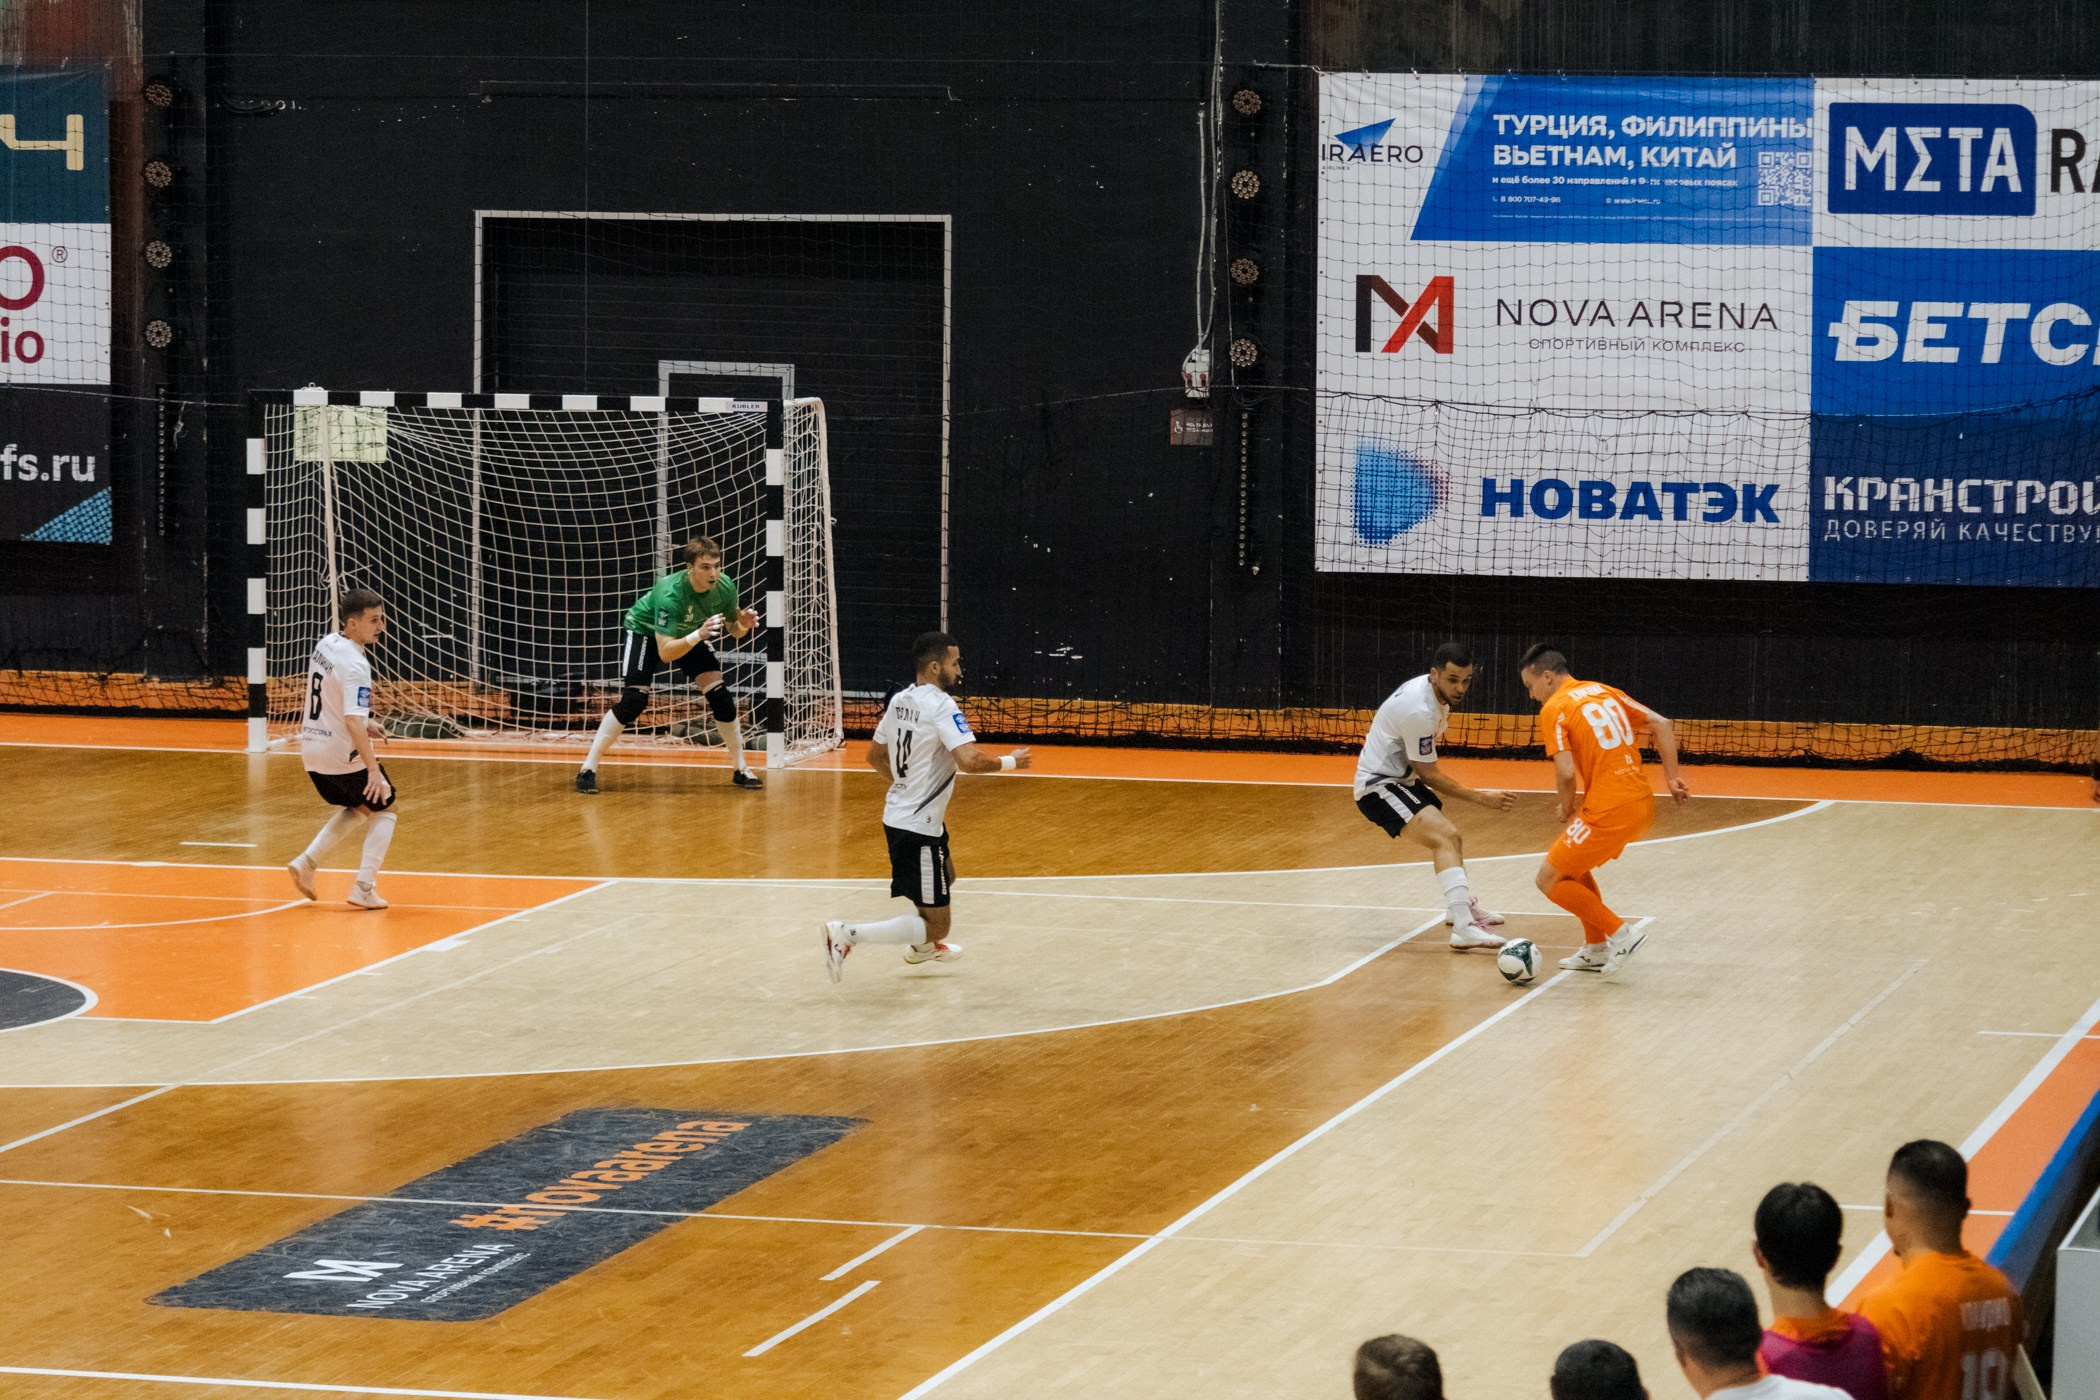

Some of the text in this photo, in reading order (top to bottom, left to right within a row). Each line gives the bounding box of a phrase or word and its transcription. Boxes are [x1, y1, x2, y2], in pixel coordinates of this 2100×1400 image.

[1492, 114, 1813, 140] ТУРЦИЯ, ФИЛИППИНЫ
[1321, 143, 1424, 163] IRAERO
[1493, 141, 1737, 171] ВЬЕТНАМ, КИТАЙ
[1500, 175, 1520, 185] ещё
[1522, 176, 1550, 184] более
[1552, 176, 1565, 185] 30
[1567, 176, 1629, 187] направлений
[1496, 298, 1778, 331] NOVA ARENA
[1529, 335, 1746, 354] СПОРТИВНЫЙ КОМПЛЕКС
[1828, 300, 2100, 366] БЕТС
[0, 443, 96, 482] fs.ru
[1480, 477, 1781, 524] НОВАТЭК
[1824, 517, 1946, 542] ДОВЕРЯЙ
[309, 671, 324, 721] 8
[1581, 697, 1634, 751] 80
[896, 727, 913, 778] 14
[1566, 817, 1592, 845] 80
[449, 1120, 752, 1231] #novaarena
[346, 1244, 515, 1309] NOVA ARENA
